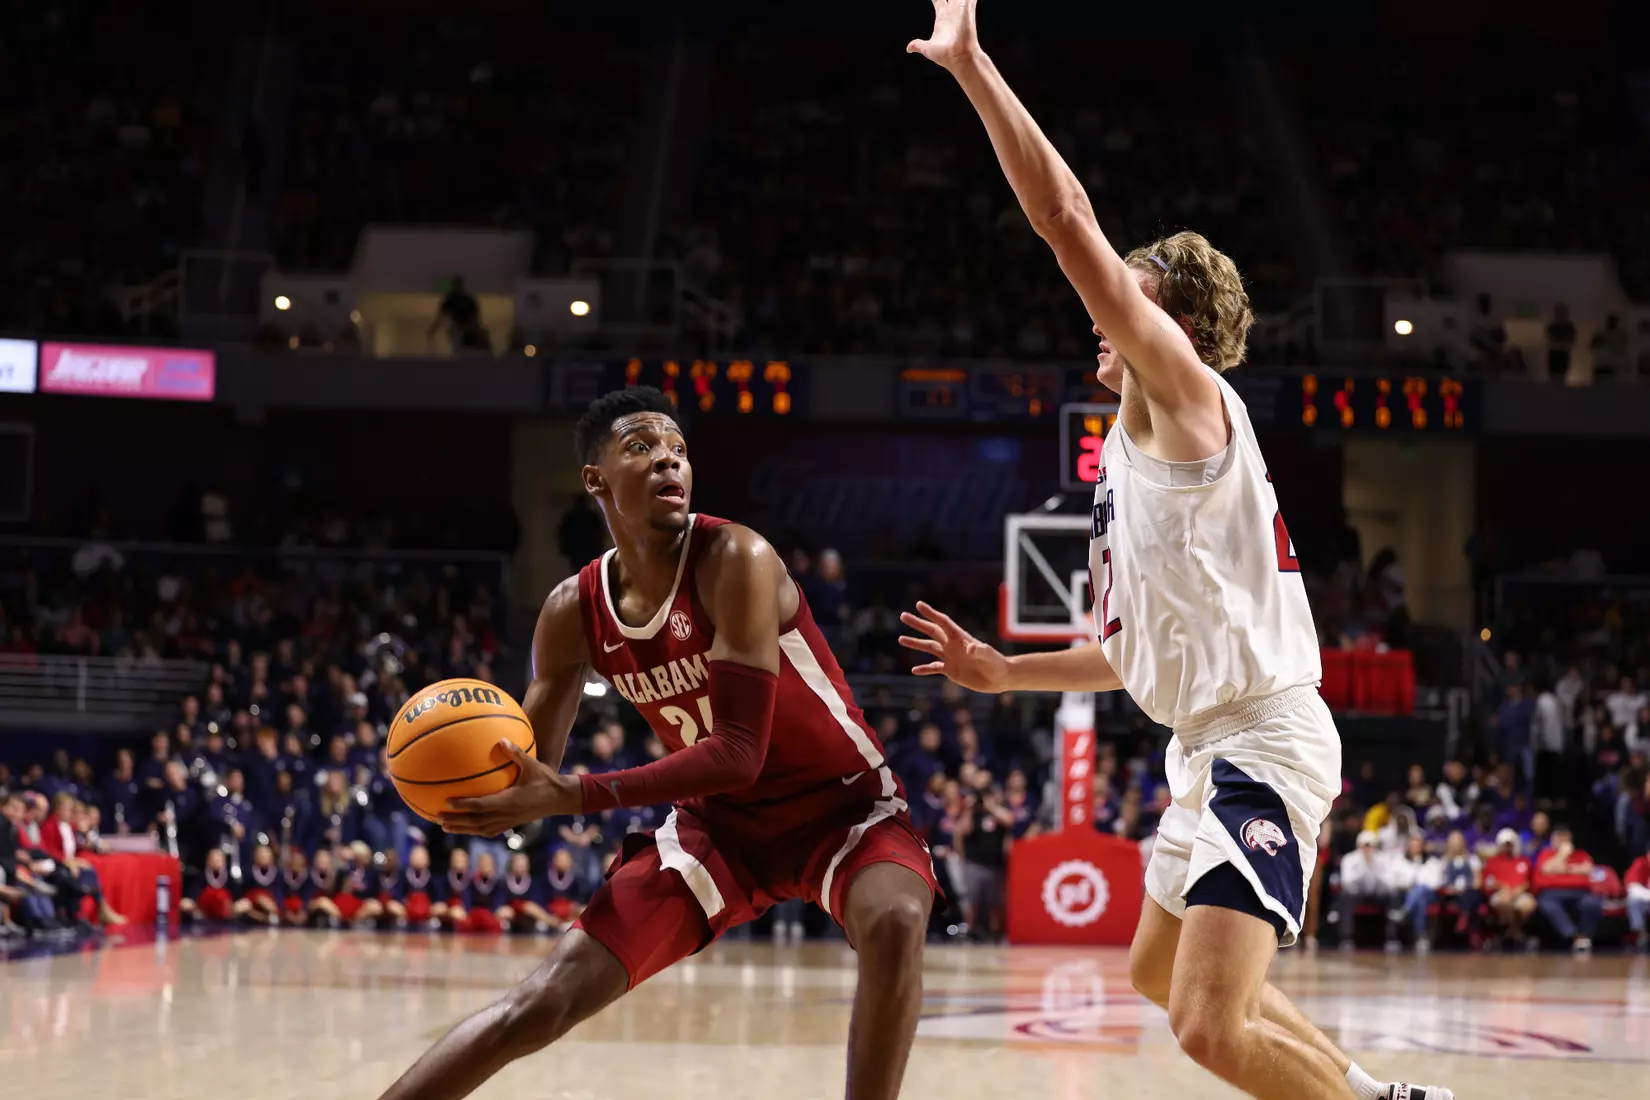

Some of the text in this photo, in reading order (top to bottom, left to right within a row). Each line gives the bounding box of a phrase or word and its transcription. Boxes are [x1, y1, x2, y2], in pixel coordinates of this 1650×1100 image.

[670, 612, 692, 640] SEC
[612, 650, 713, 704] ALABAM
[404, 687, 505, 724] Wilson
